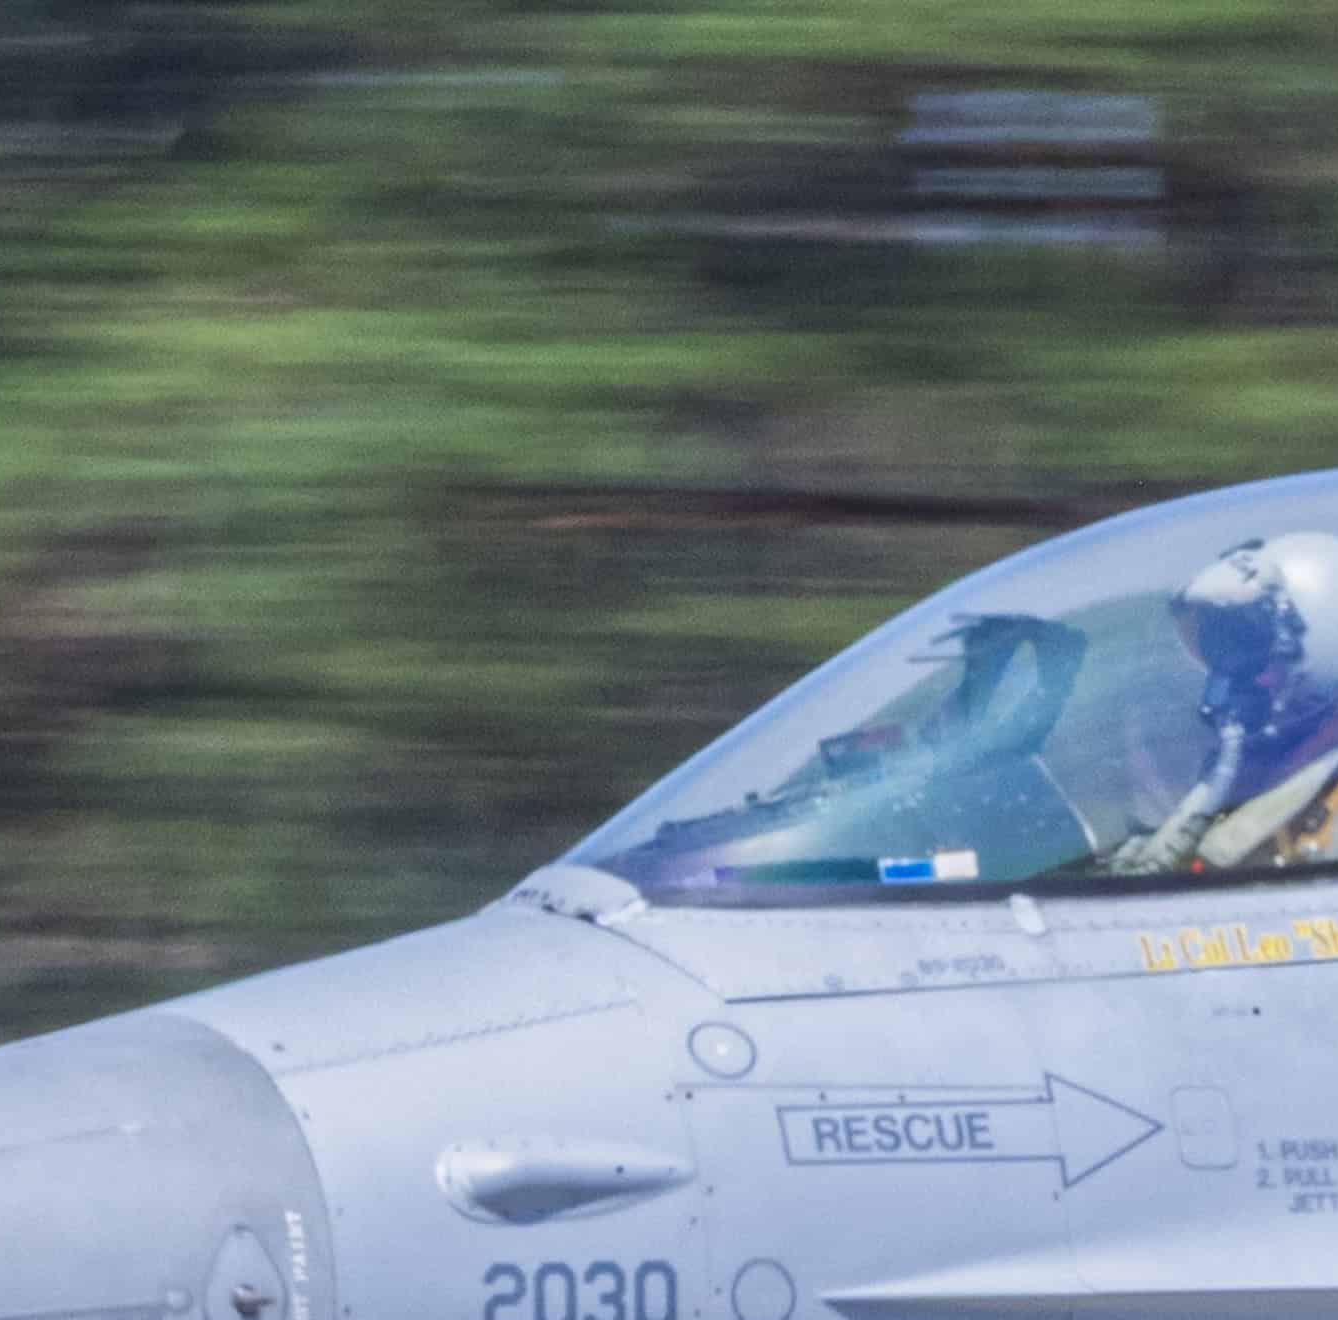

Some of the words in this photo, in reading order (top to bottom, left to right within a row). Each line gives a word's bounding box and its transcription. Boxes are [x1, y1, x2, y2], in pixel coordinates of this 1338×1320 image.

[1180, 927, 1230, 965] Col
[812, 1112, 994, 1152] RESCUE
[1257, 1139, 1273, 1160] 1.
[1284, 1165, 1336, 1188] PULL
